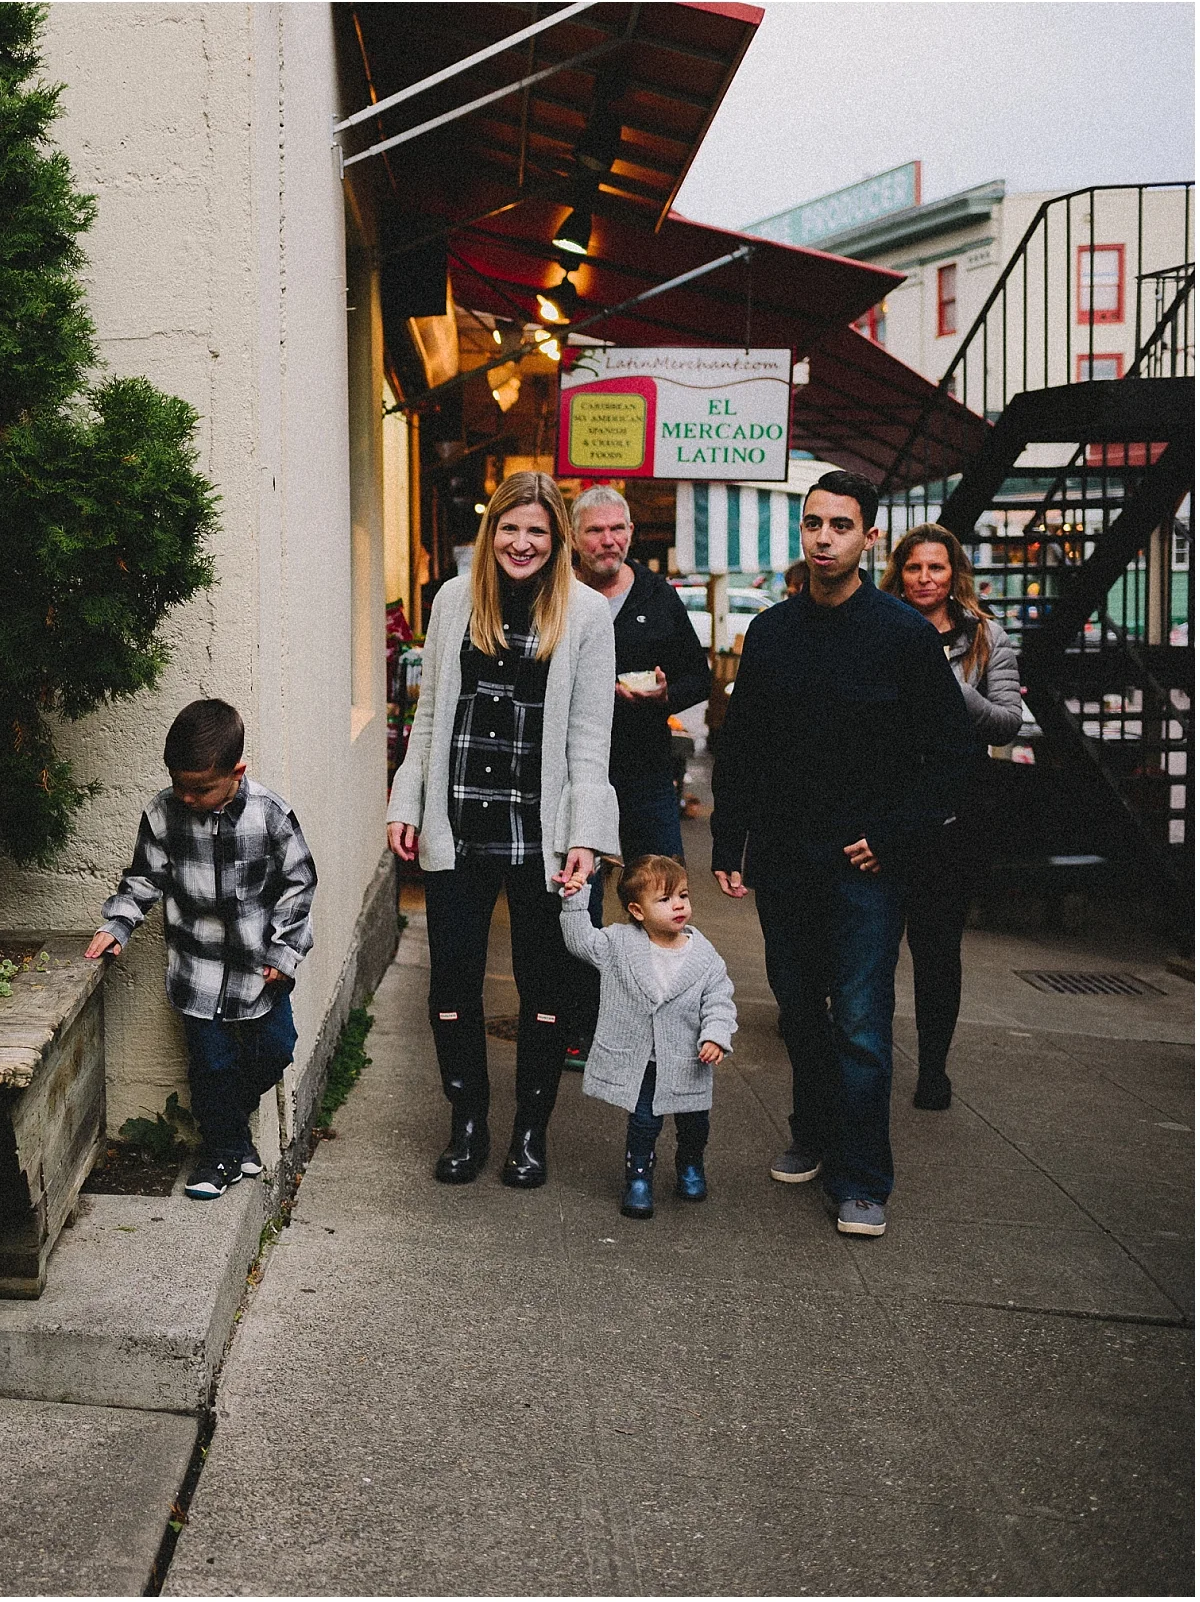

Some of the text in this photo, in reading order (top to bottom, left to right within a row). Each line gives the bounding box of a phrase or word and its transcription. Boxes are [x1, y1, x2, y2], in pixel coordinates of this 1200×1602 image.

[708, 398, 737, 415] EL
[661, 422, 783, 440] MERCADO
[677, 446, 766, 464] LATINO
